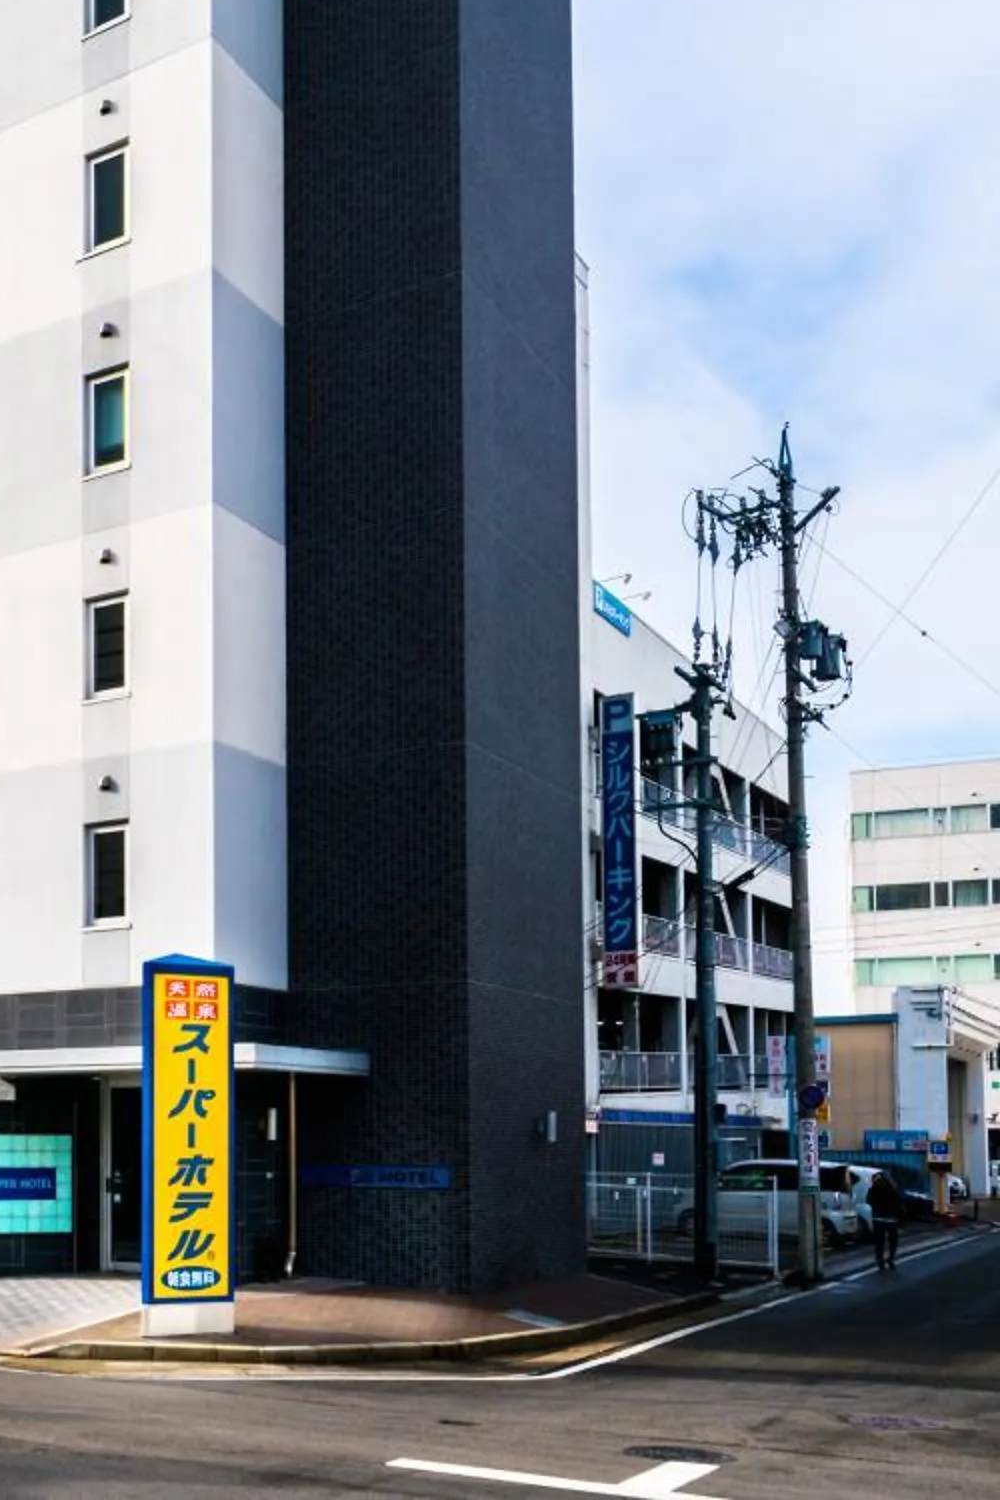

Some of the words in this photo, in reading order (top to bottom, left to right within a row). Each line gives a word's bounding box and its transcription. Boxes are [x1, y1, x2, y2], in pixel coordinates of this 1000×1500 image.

[607, 741, 632, 944] シルクパーキング
[168, 1024, 216, 1260] スーパーホテル
